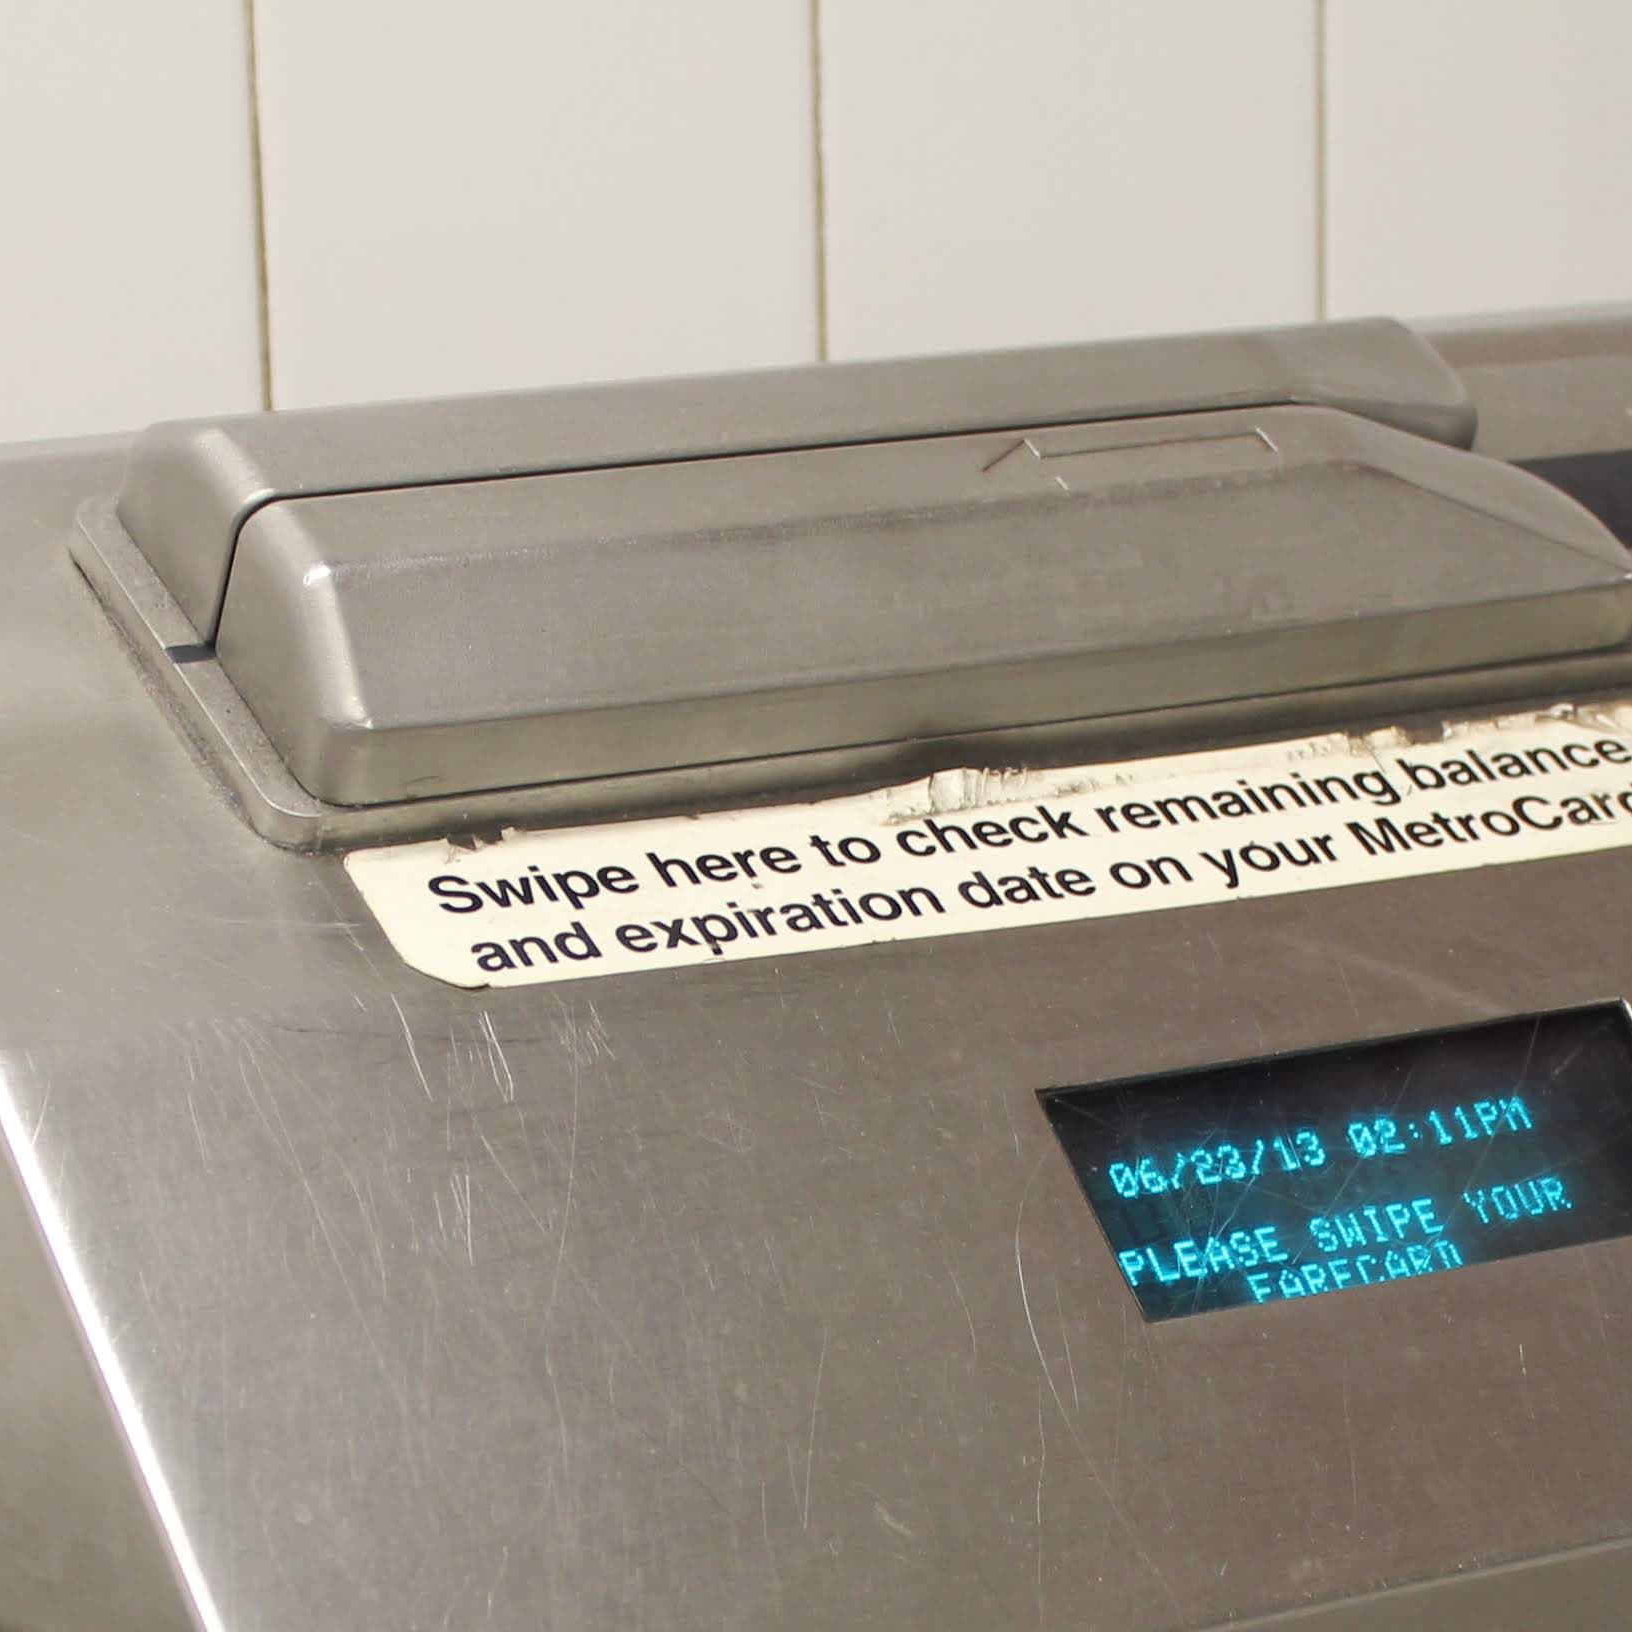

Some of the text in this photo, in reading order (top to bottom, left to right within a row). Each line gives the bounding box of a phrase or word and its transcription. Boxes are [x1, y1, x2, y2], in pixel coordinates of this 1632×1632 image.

[428, 861, 640, 914] Swipe
[648, 843, 799, 890] here
[811, 828, 881, 870] to
[895, 803, 1090, 861] check
[1098, 762, 1403, 831] remaining
[470, 921, 601, 972] and
[616, 881, 945, 954] expiration
[958, 861, 1098, 911] date
[1109, 852, 1189, 890] on
[1203, 833, 1341, 888] your
[1109, 1097, 1533, 1199] 06/23/13 02:11PM
[1118, 1176, 1573, 1286] PLEASE SWIPE YOUR
